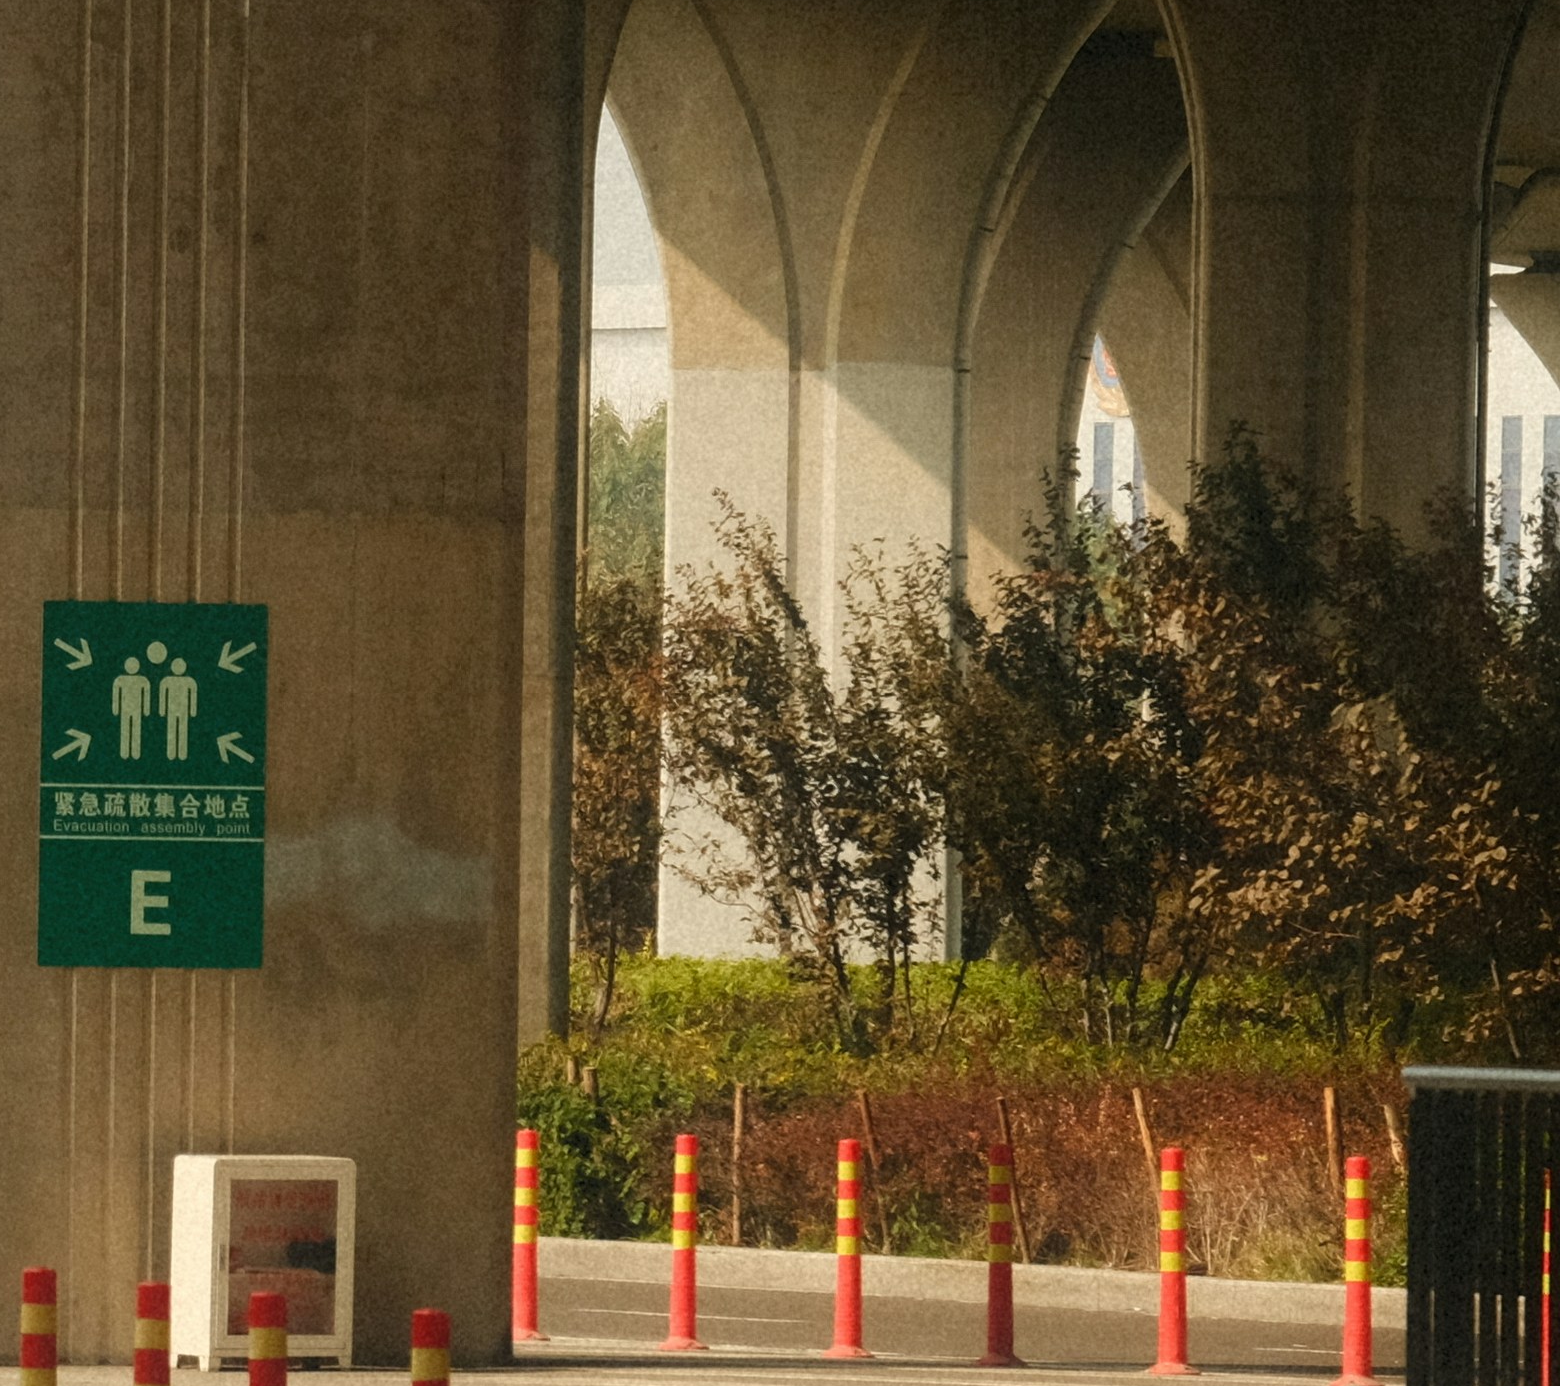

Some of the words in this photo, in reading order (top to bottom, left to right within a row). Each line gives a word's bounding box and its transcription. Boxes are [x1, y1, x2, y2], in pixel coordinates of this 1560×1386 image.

[54, 791, 251, 819] 紧急疏散集合地点
[53, 819, 130, 832] Evacuation
[140, 821, 206, 835] assembly
[216, 822, 251, 836] point
[130, 870, 171, 935] E
